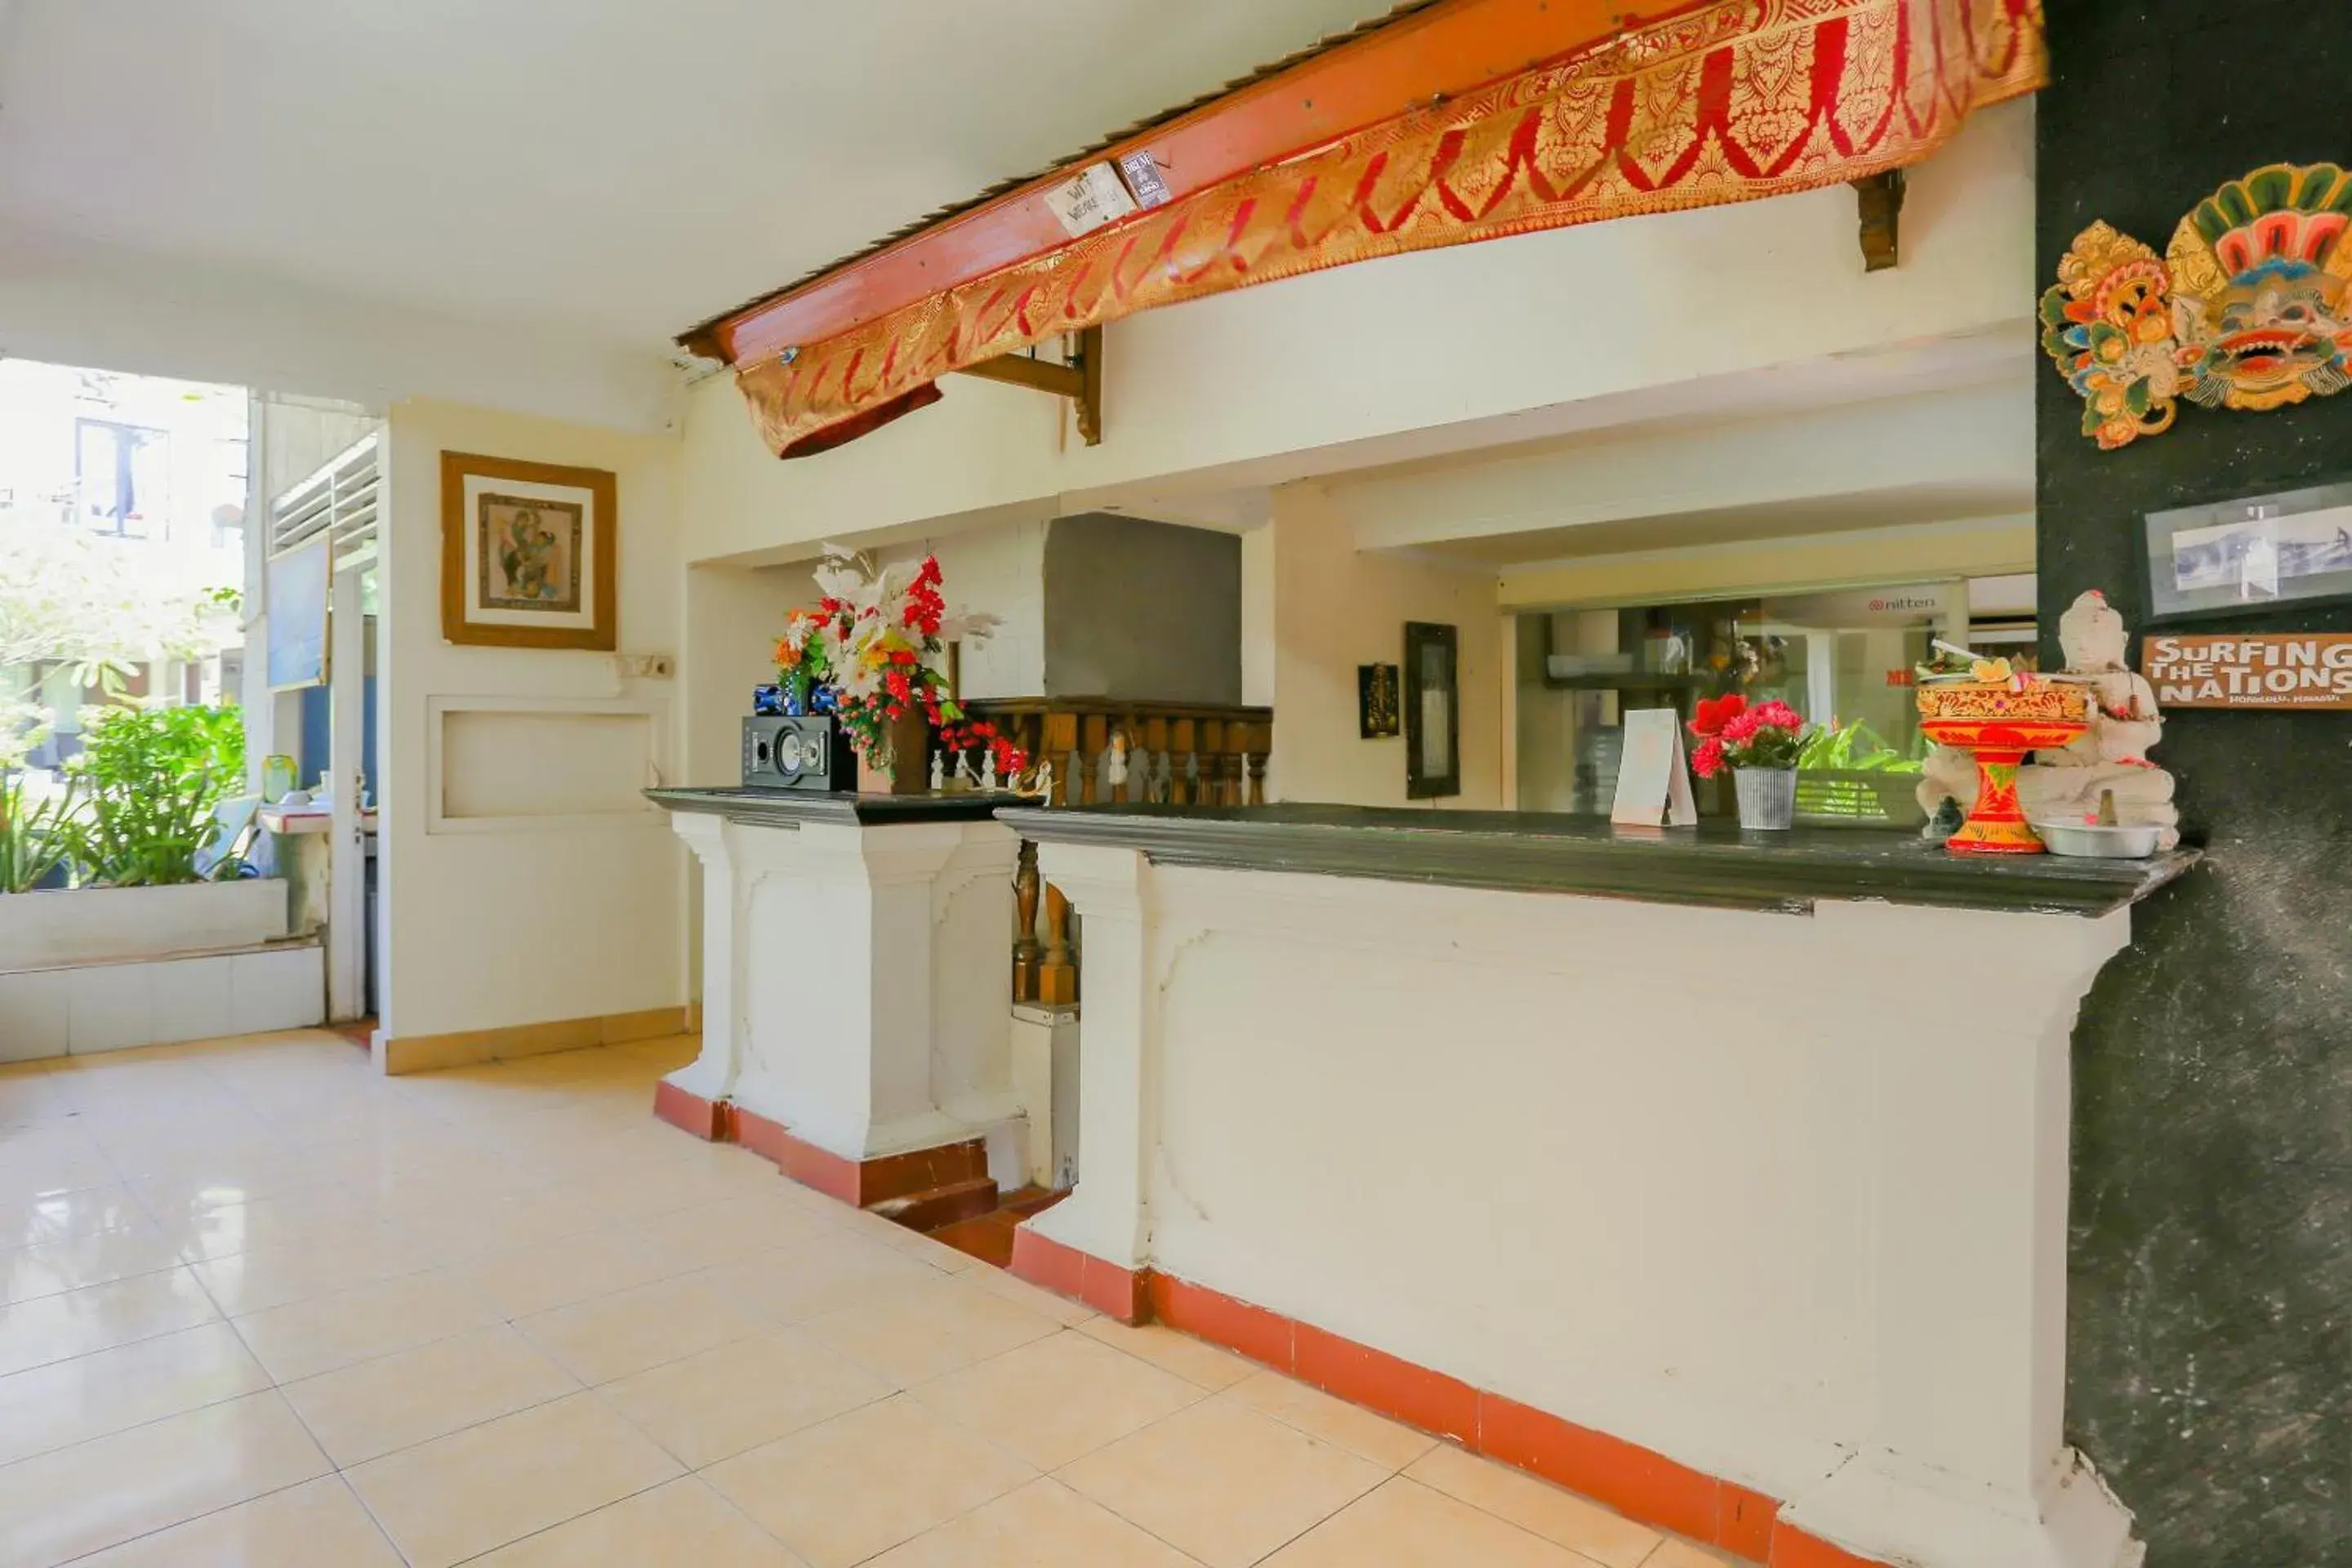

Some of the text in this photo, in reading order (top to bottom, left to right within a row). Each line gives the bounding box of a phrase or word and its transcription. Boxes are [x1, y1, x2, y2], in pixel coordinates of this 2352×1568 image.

[2155, 639, 2352, 669] SURFING
[2147, 662, 2215, 681] THE
[2160, 666, 2352, 702] NATIONS
